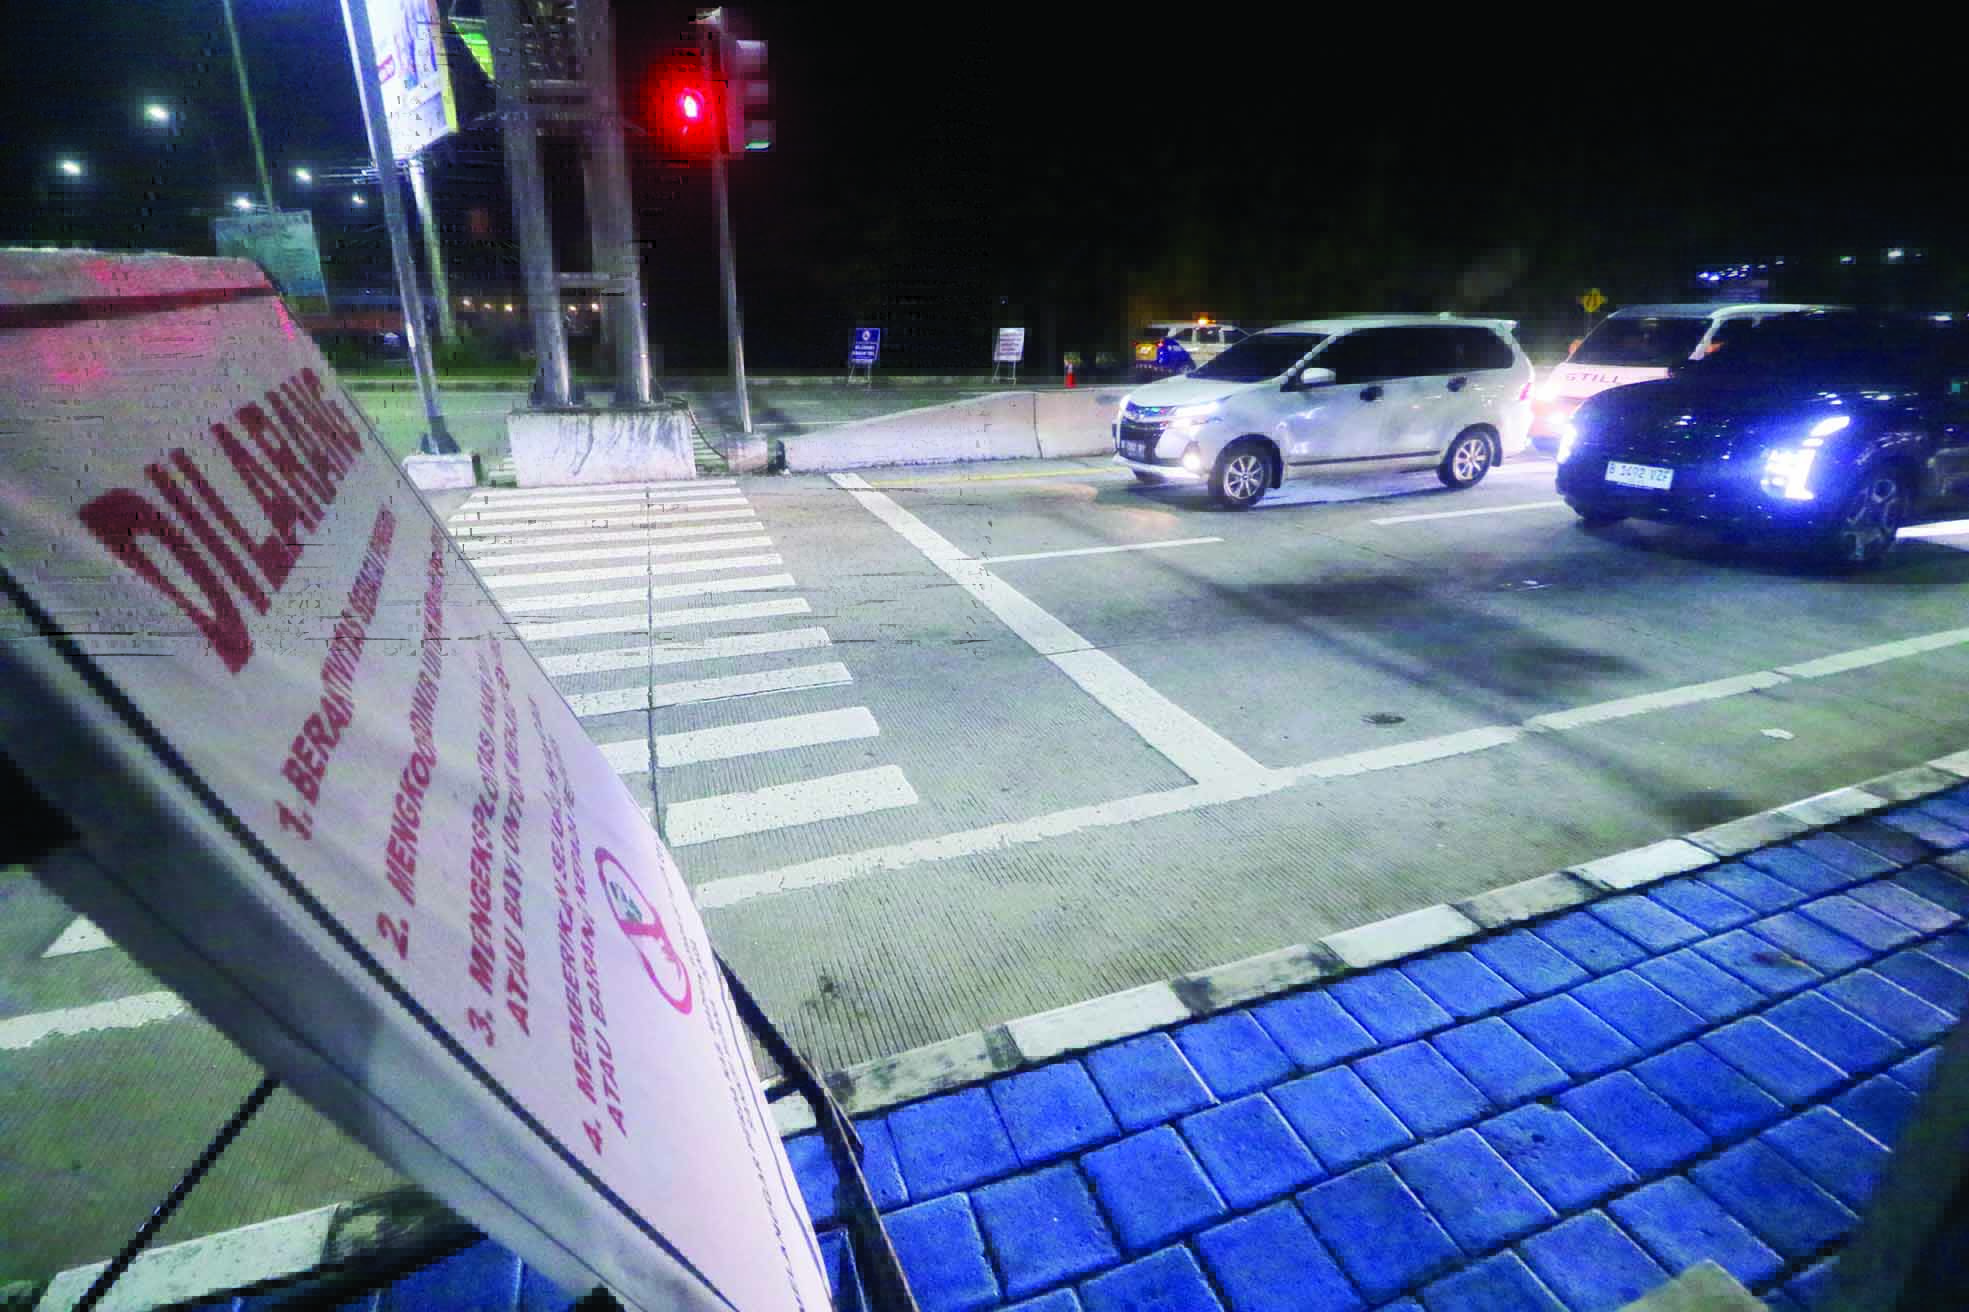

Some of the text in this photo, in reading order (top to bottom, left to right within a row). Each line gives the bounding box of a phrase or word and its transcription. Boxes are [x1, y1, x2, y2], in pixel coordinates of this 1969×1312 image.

[77, 366, 364, 676] DILARANG
[275, 799, 314, 841] 1.
[376, 911, 409, 961] 2.
[504, 926, 531, 1038] ATAU
[468, 1006, 495, 1048] 3.
[594, 1027, 628, 1138] ATAU
[582, 1119, 604, 1156] 4.
